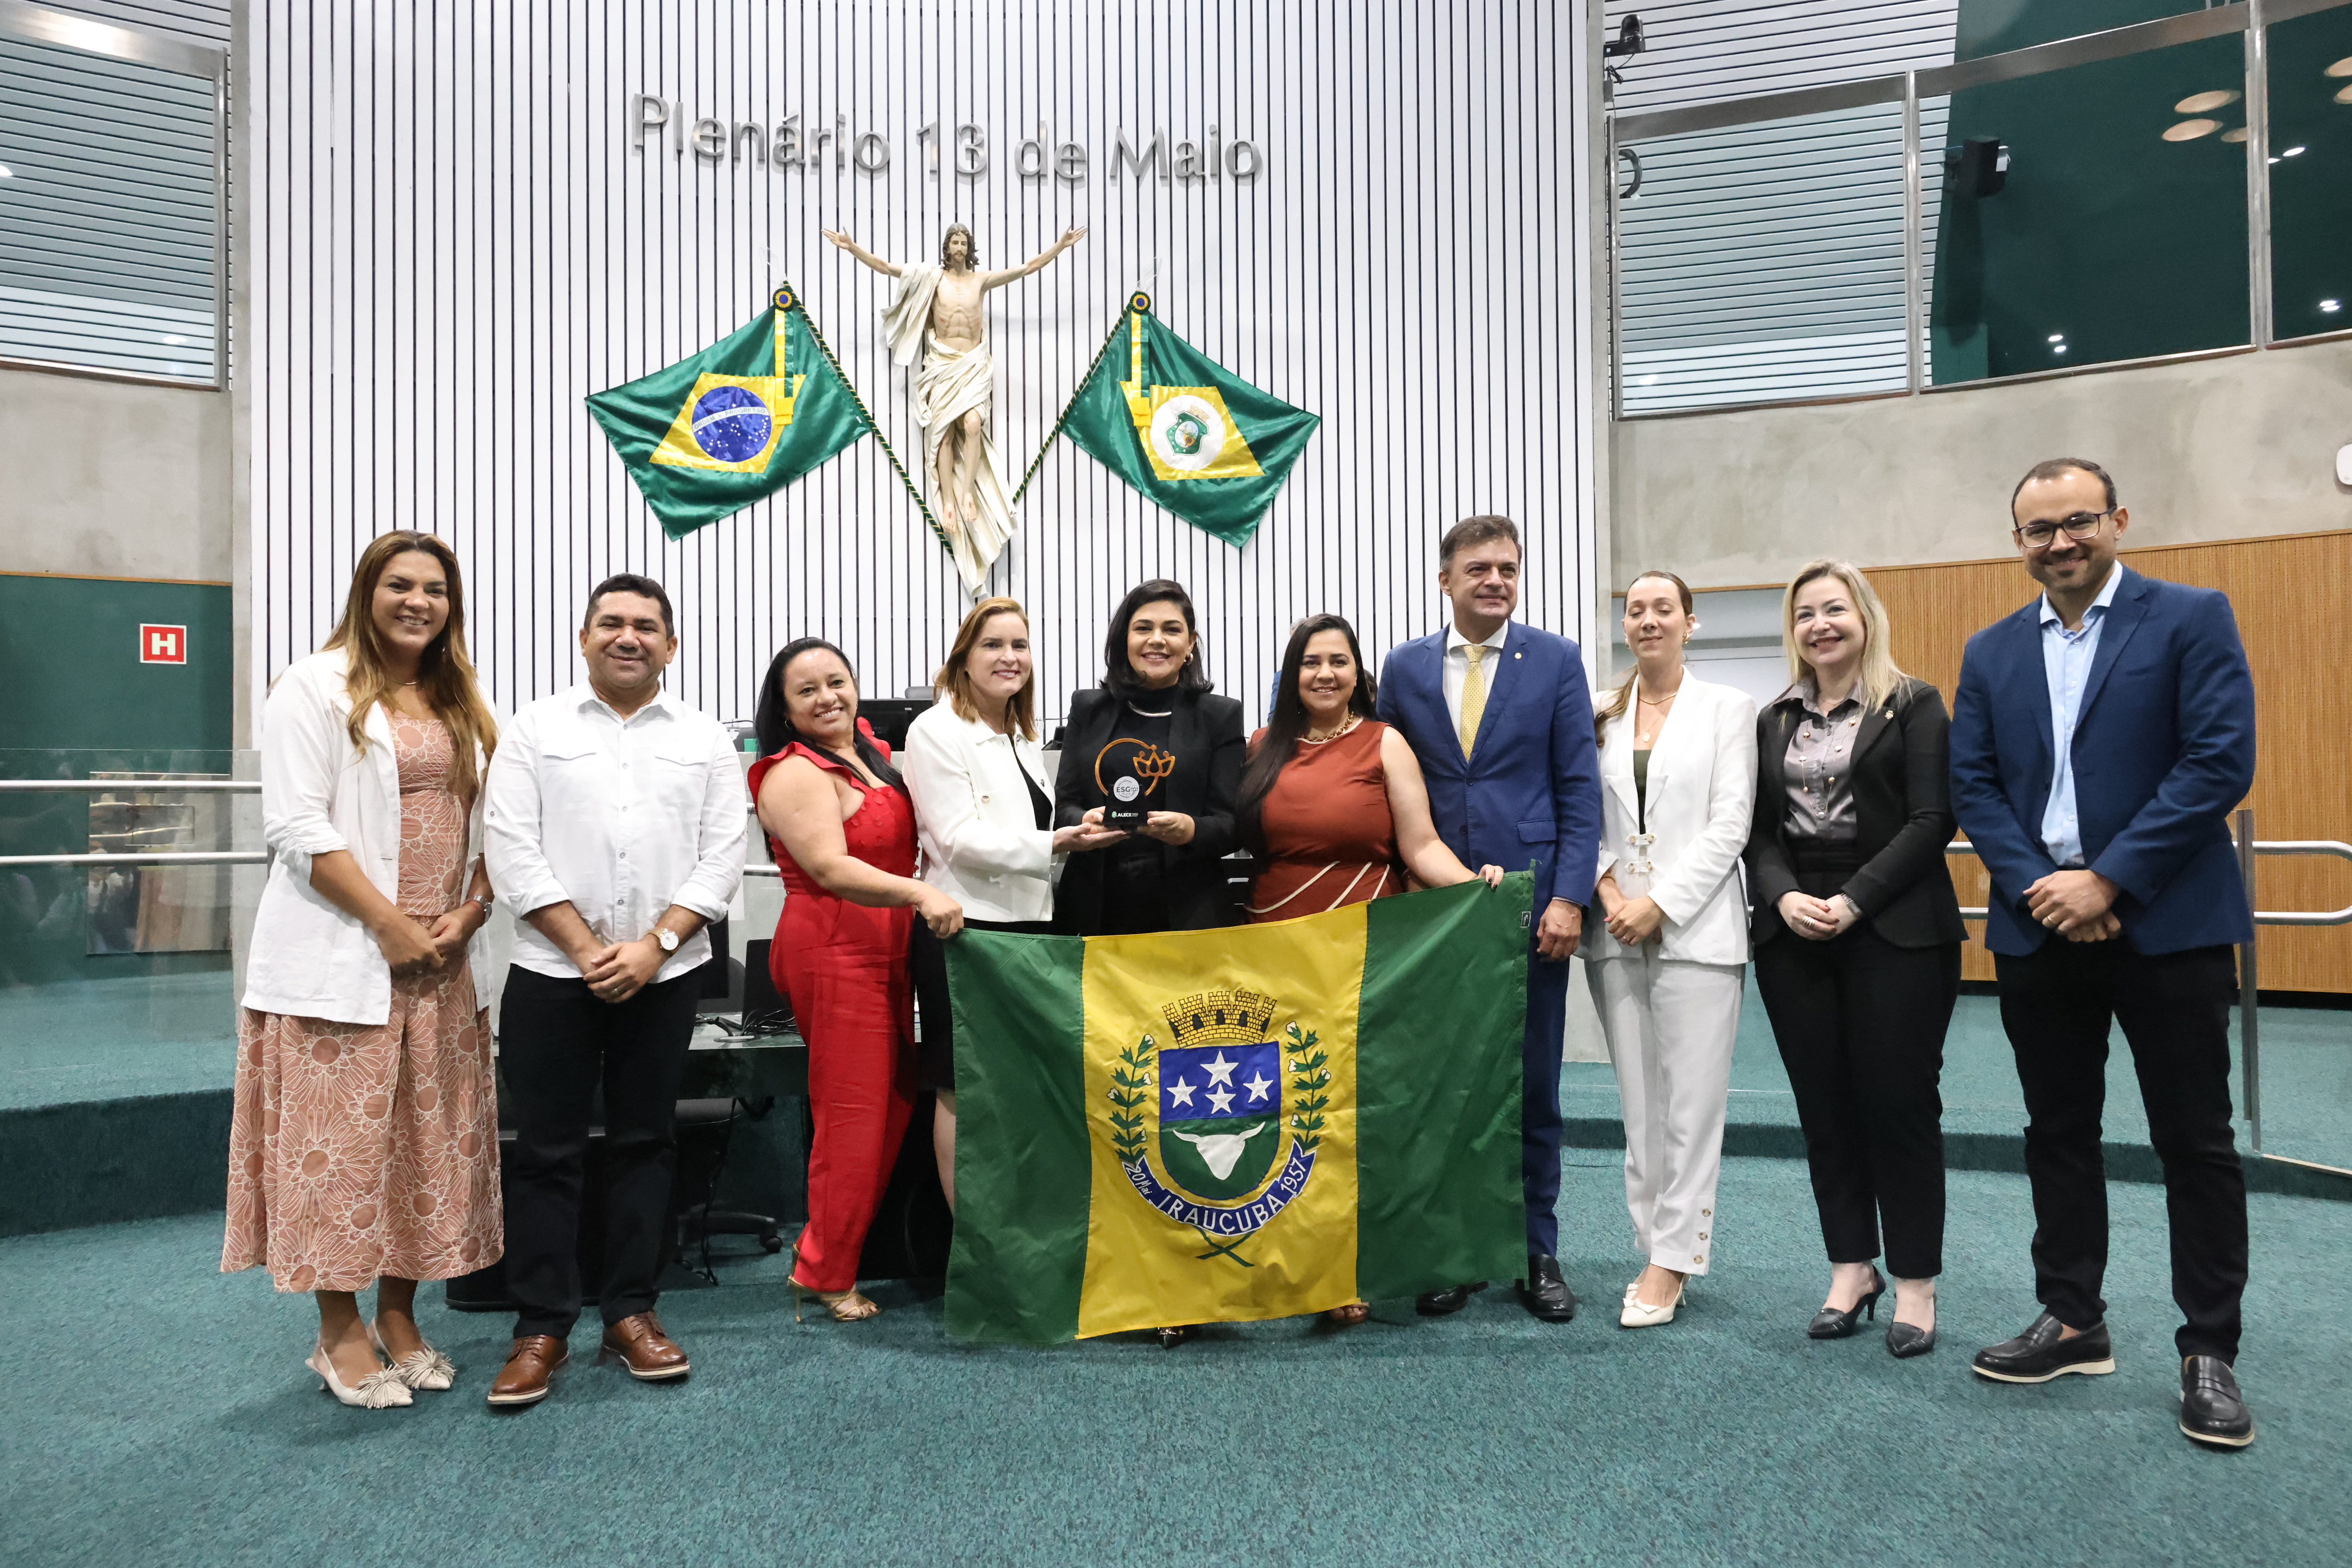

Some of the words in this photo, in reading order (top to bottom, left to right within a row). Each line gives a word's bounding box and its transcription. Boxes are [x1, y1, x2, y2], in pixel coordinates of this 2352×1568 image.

[631, 93, 890, 171] Plenário
[916, 121, 988, 175] 13
[1014, 120, 1087, 180] de
[1110, 124, 1262, 180] Maio
[694, 416, 716, 429] ORDEM
[725, 408, 765, 416] PROGRESSO
[151, 633, 176, 656] H
[1157, 1193, 1285, 1235] IRAUÇUBA
[1280, 1157, 1306, 1195] 1957
